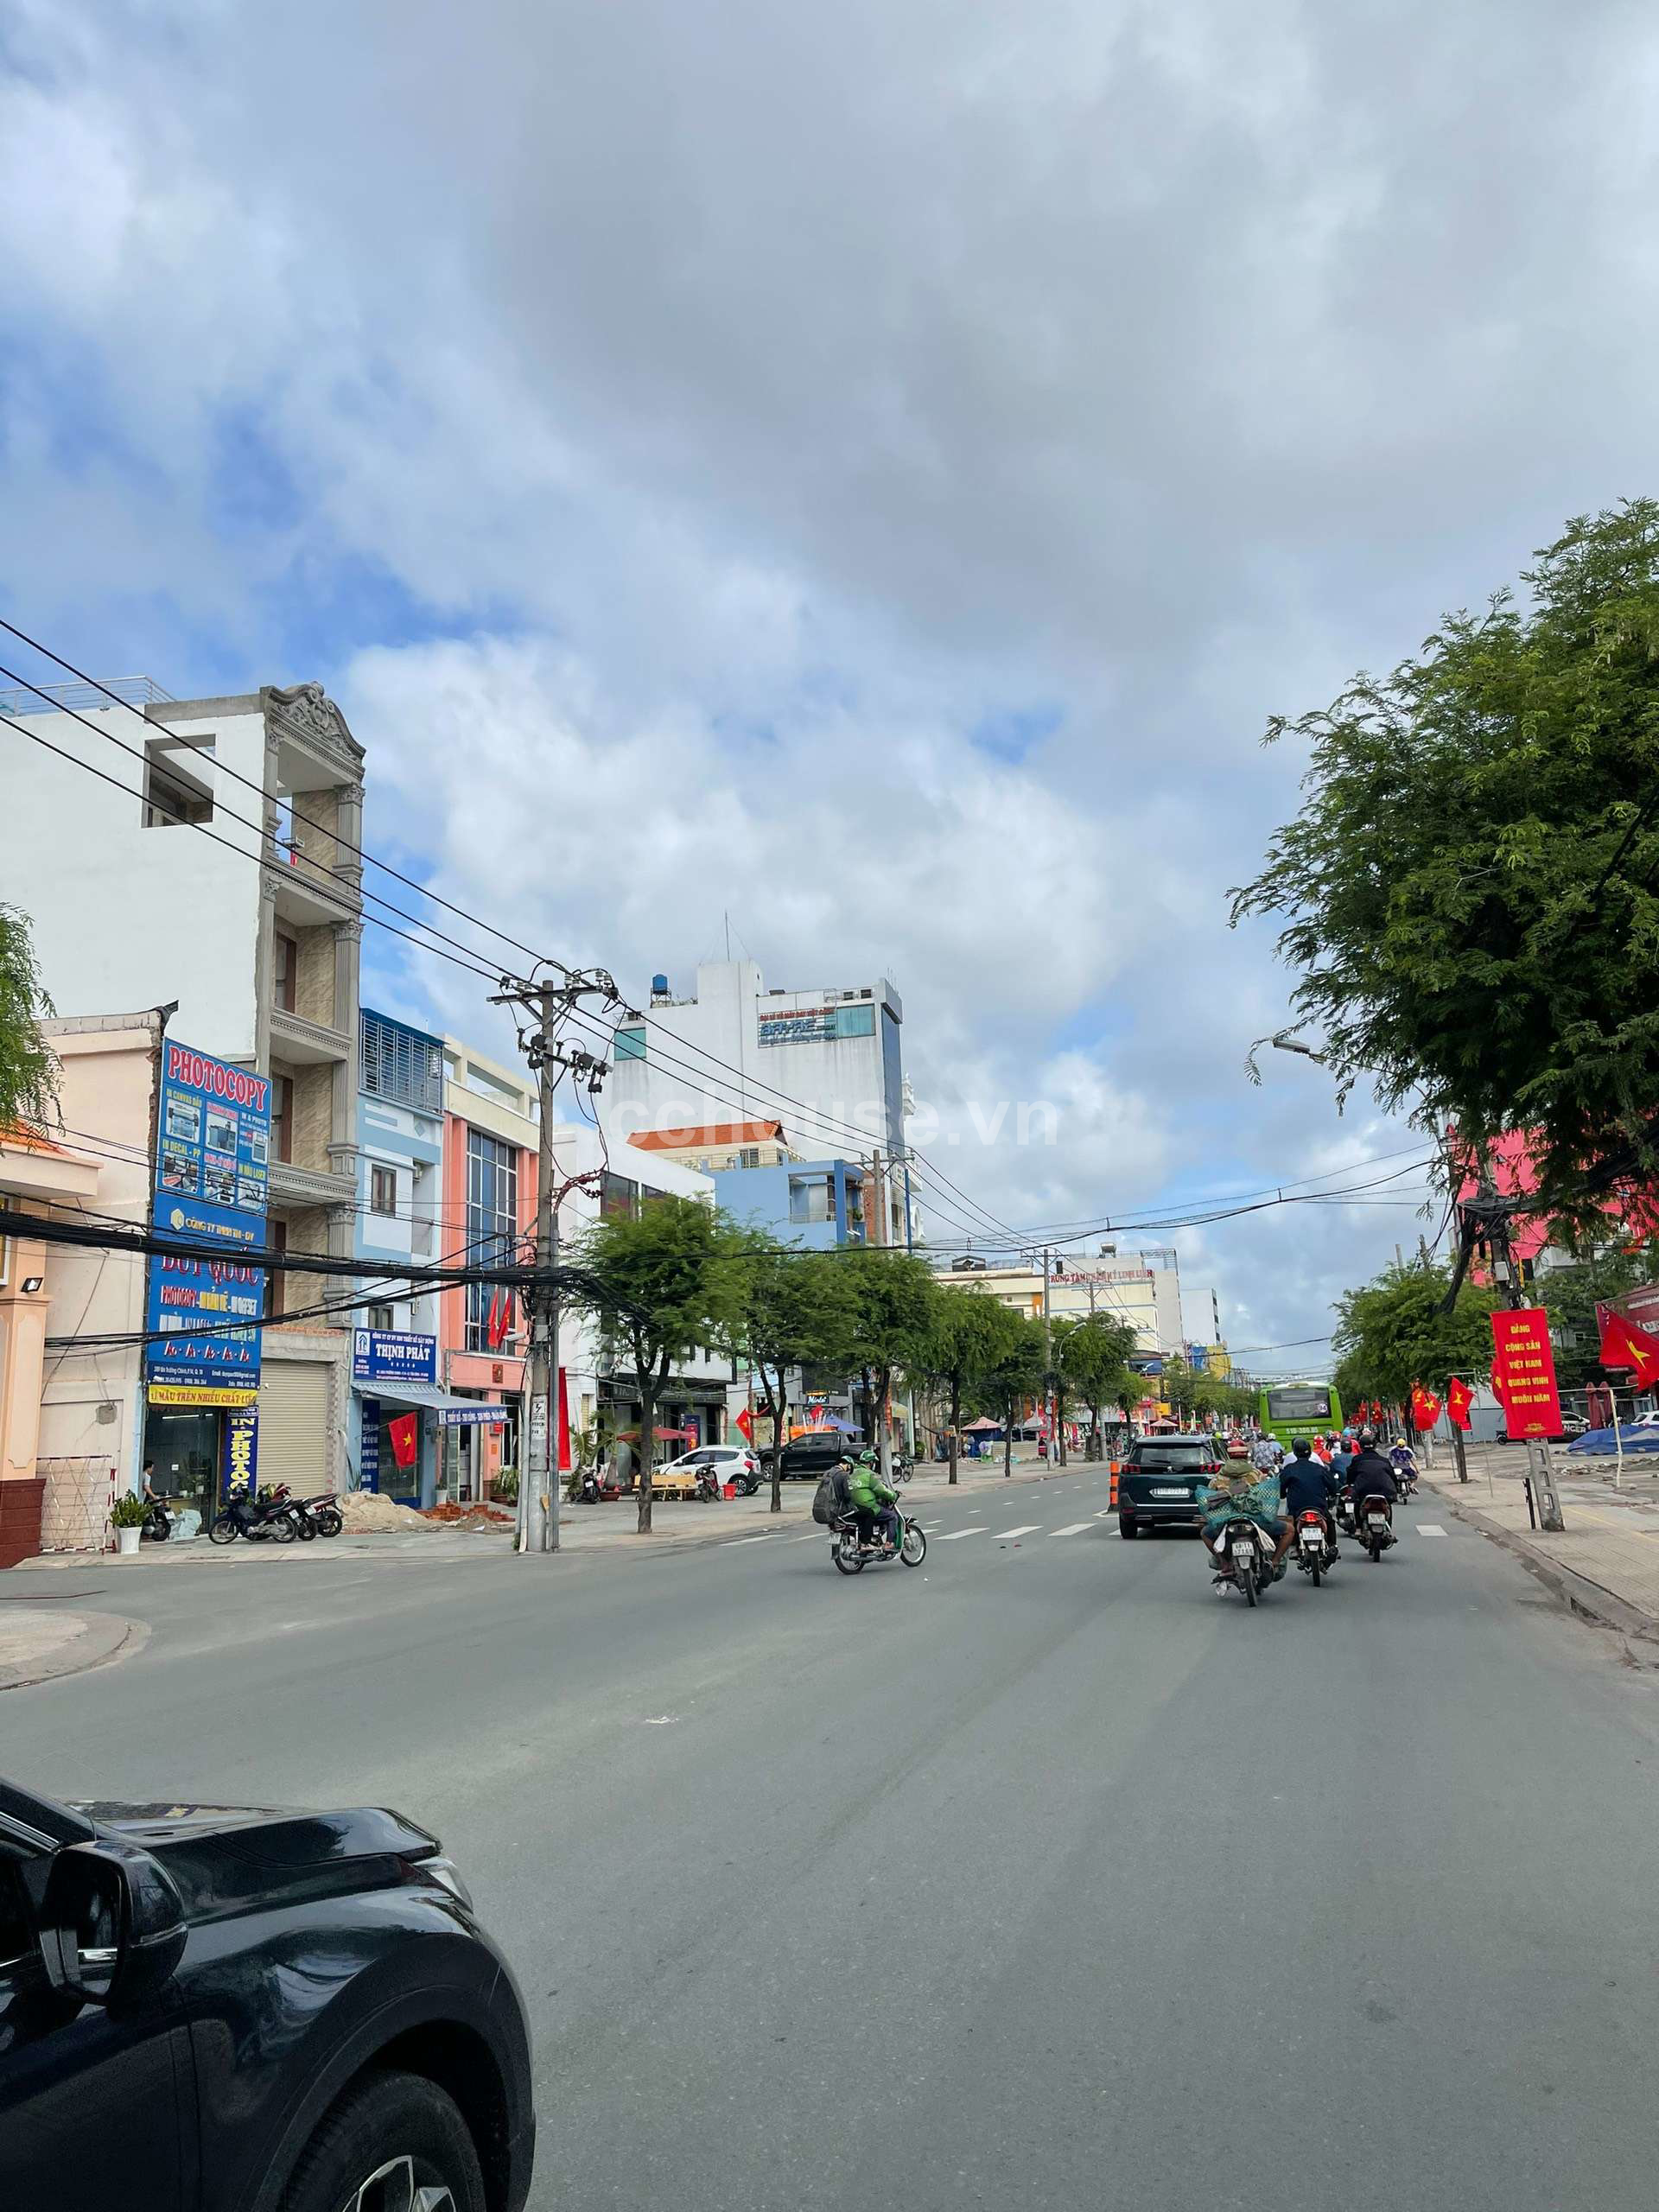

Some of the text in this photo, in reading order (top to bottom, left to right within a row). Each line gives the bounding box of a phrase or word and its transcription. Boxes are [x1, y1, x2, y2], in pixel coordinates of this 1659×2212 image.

[168, 1045, 267, 1111] PHOTOCOPY
[1510, 1322, 1530, 1334] ĐẢNG
[375, 1343, 430, 1361] THỊNH PHÁT
[1505, 1339, 1541, 1353] CỘNG SẢN
[1509, 1359, 1542, 1370] VIỆT NAM
[1507, 1376, 1548, 1388] QUANG VINH
[1511, 1393, 1550, 1404] MUÔN NĂM
